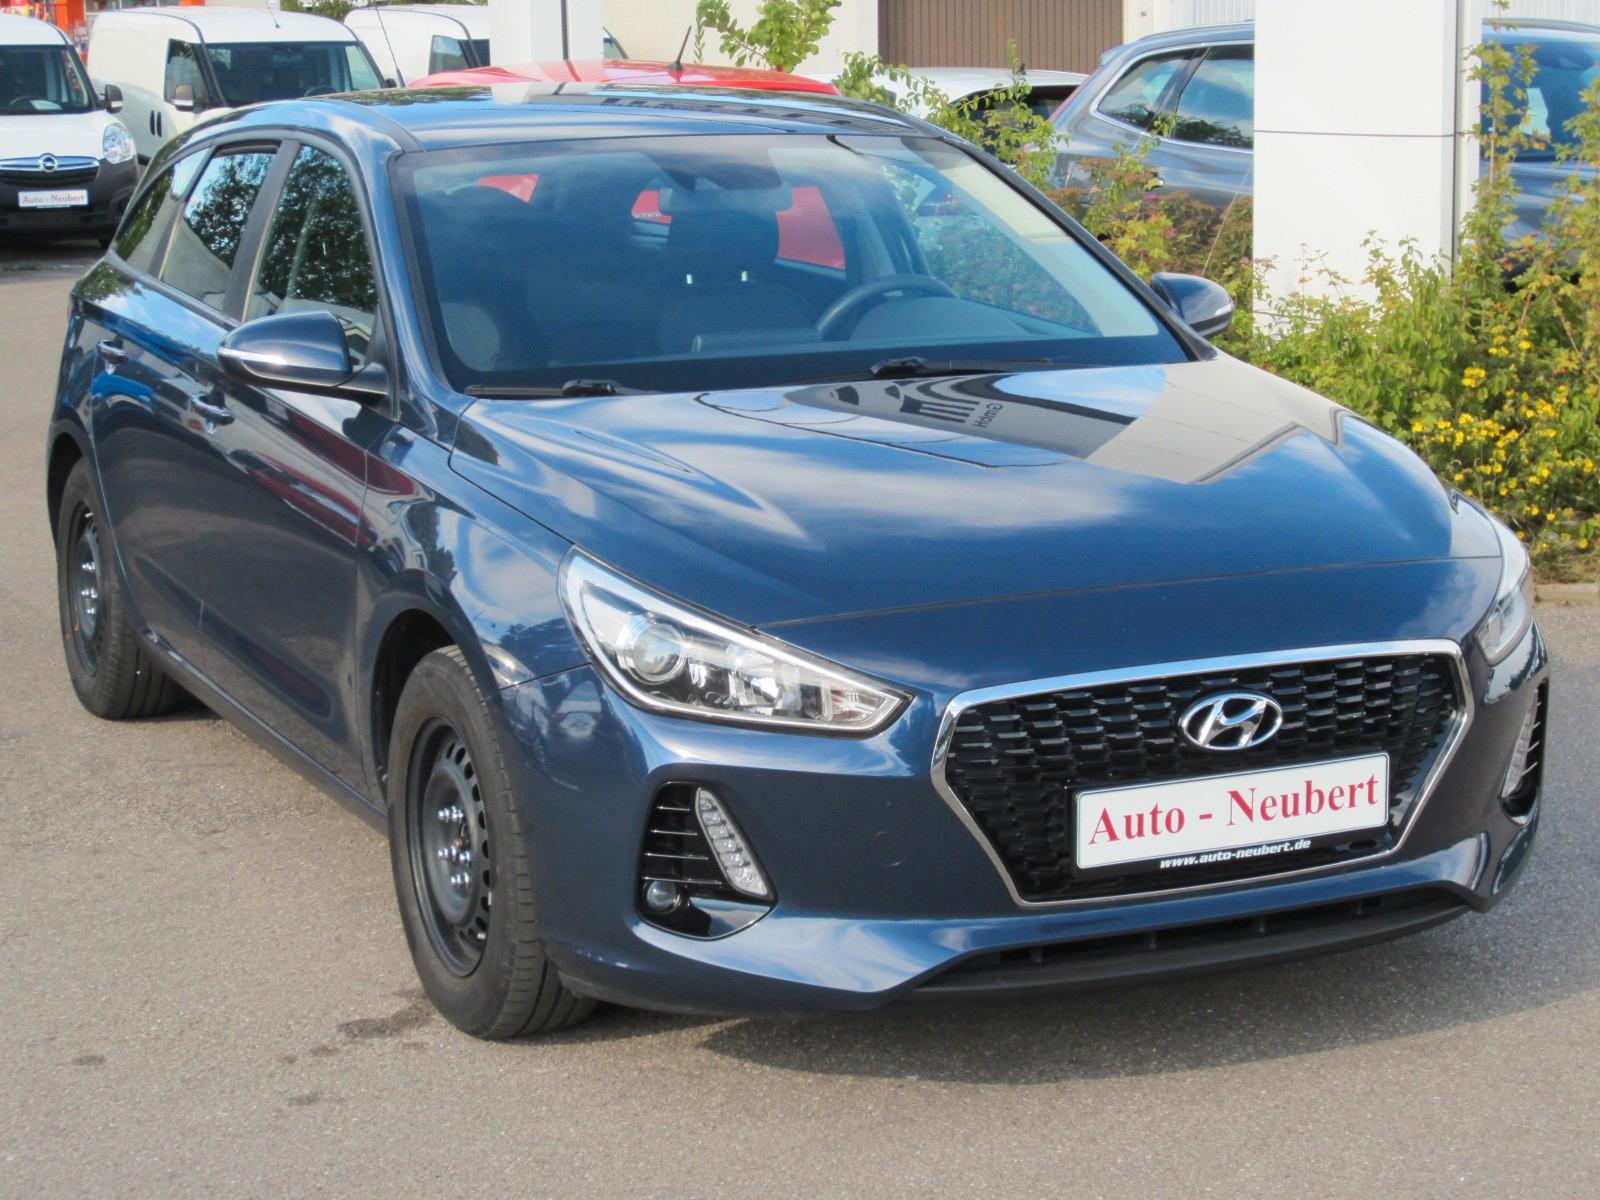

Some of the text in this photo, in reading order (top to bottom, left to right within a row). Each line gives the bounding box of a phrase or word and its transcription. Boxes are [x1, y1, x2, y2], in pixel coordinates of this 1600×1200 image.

[22, 195, 44, 204] Auto
[50, 193, 85, 202] Neubert
[1088, 801, 1185, 845] Auto
[1227, 772, 1379, 826] Neubert
[1160, 838, 1311, 869] www.auto-neubert.de
